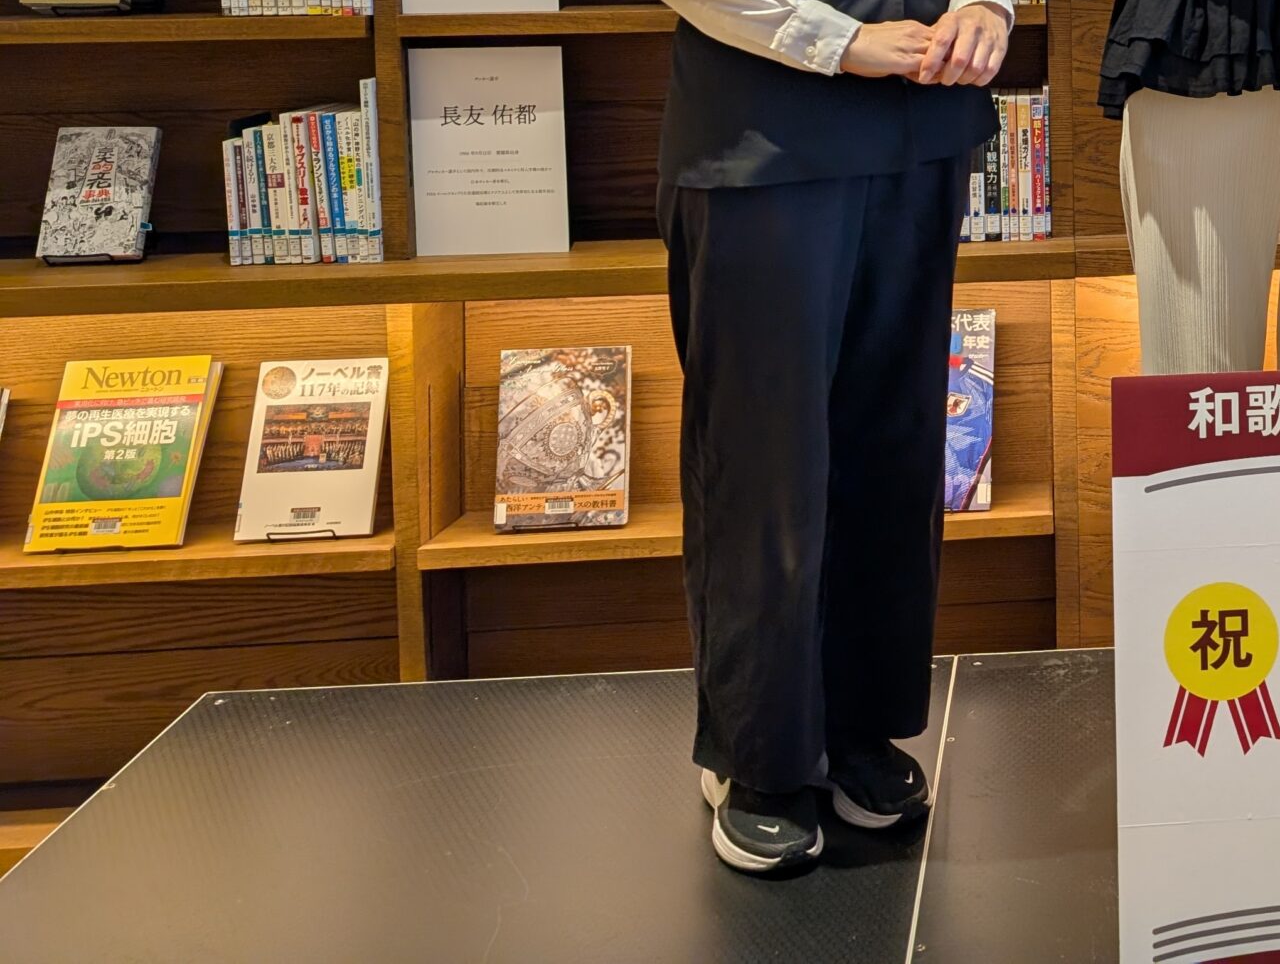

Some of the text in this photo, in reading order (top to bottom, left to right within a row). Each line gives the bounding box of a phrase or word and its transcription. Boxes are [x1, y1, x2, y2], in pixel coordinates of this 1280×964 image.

[440, 105, 537, 126] 長友 佑都
[963, 335, 990, 349] 年史
[82, 366, 182, 389] Newton
[301, 365, 383, 381] ノーベル賞
[299, 381, 380, 397] 117年の記録
[65, 406, 191, 421] 夢の再生医療を実現する
[70, 419, 178, 448] iPS細胞
[103, 448, 138, 461] 第2版
[506, 500, 617, 513] 西洋アンティラスの教科書
[1190, 608, 1253, 671] 祝
